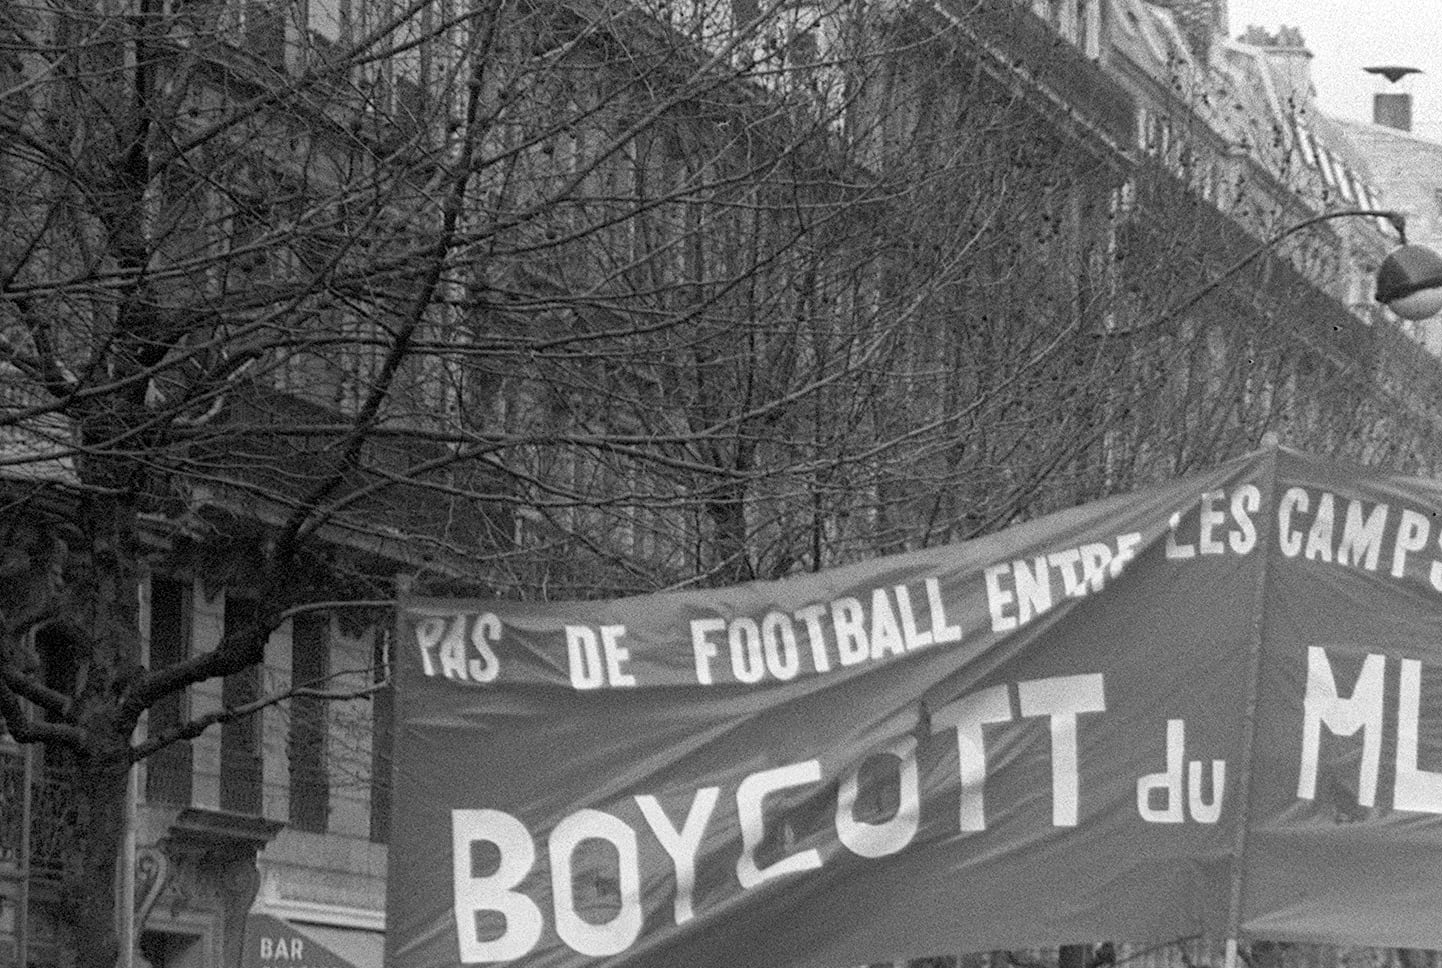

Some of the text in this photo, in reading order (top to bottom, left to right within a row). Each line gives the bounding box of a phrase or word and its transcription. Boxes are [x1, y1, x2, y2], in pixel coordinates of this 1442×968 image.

[414, 612, 503, 683] PAS
[564, 624, 636, 690] DE
[689, 578, 963, 685] FOOTBALL
[450, 673, 1107, 965] BOYCOTT
[1136, 719, 1226, 825] du
[260, 937, 303, 960] BAR
